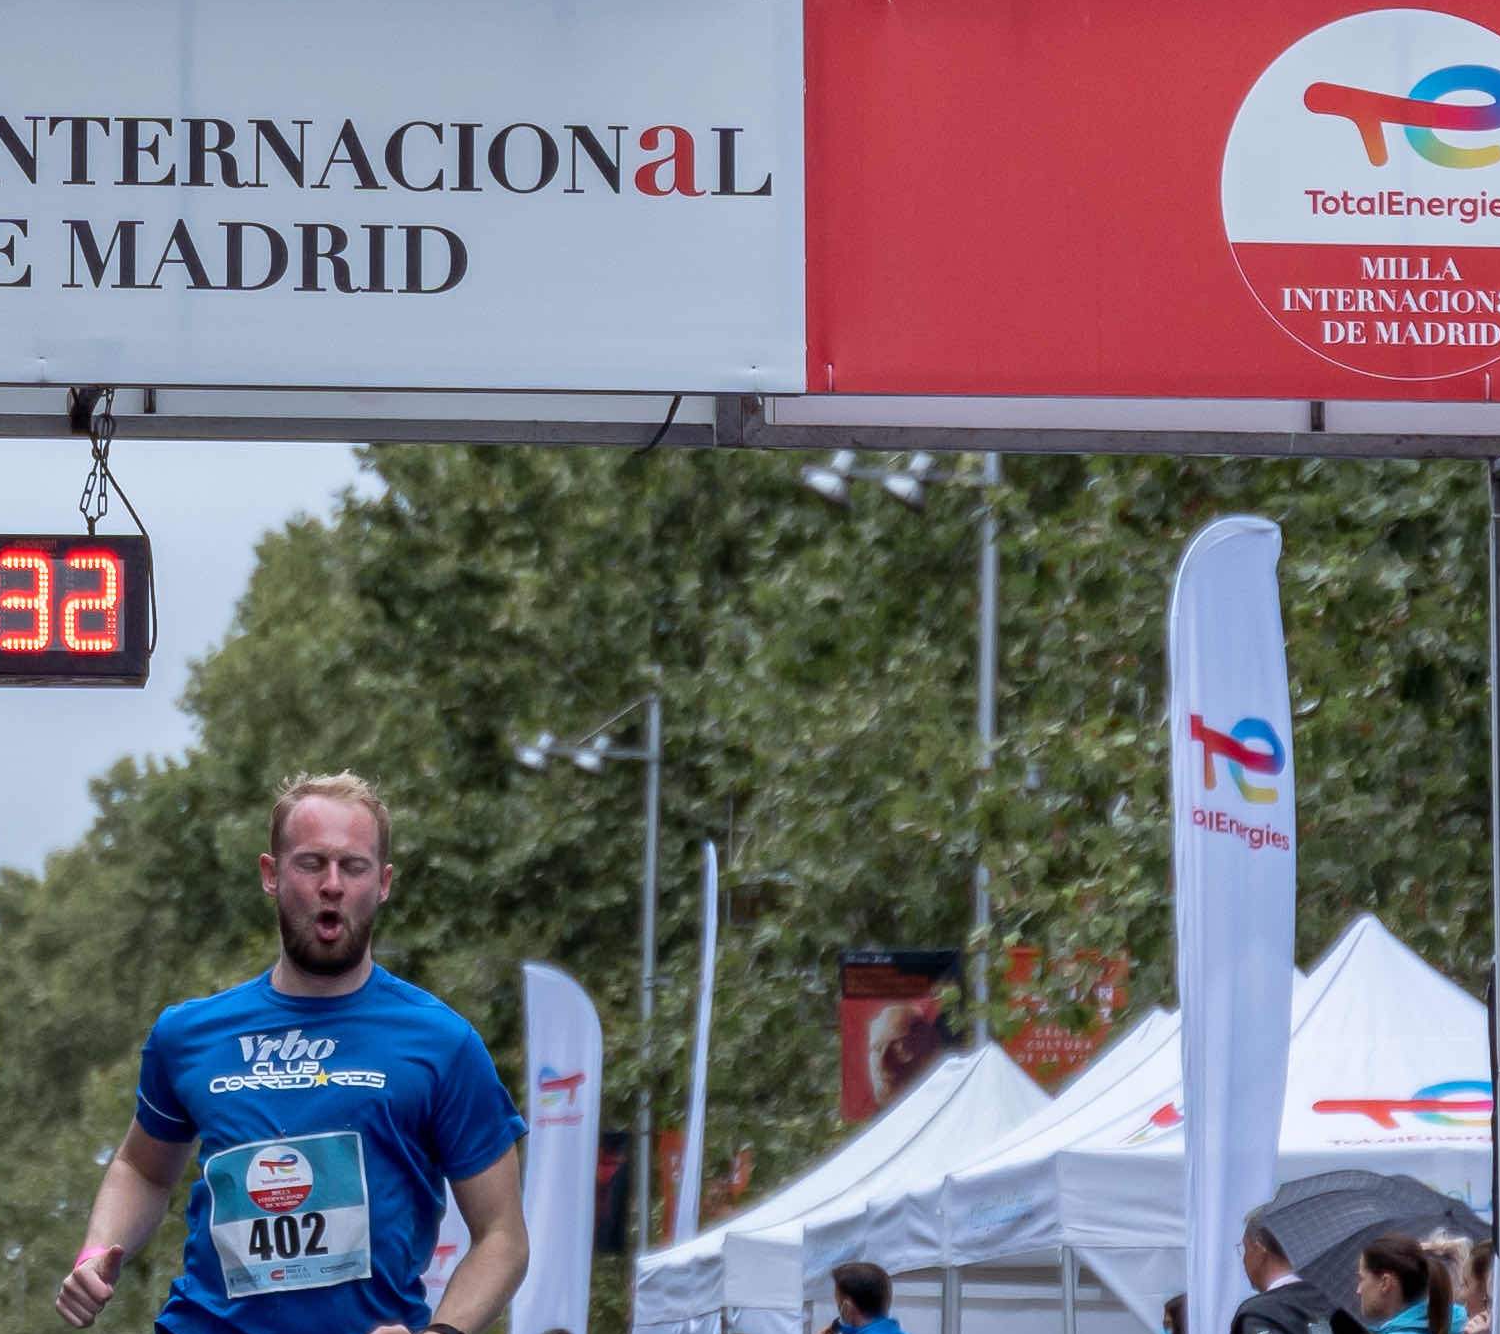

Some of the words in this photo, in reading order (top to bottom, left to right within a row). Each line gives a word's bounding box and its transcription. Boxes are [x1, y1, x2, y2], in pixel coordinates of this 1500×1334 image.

[61, 218, 468, 294] MADRID
[1361, 255, 1462, 281] MILLA
[1322, 320, 1367, 345] DE
[238, 1029, 337, 1063] Vrbo
[251, 1061, 320, 1076] CLUB
[208, 1069, 387, 1095] CORREDRES
[248, 1211, 329, 1262] 402
